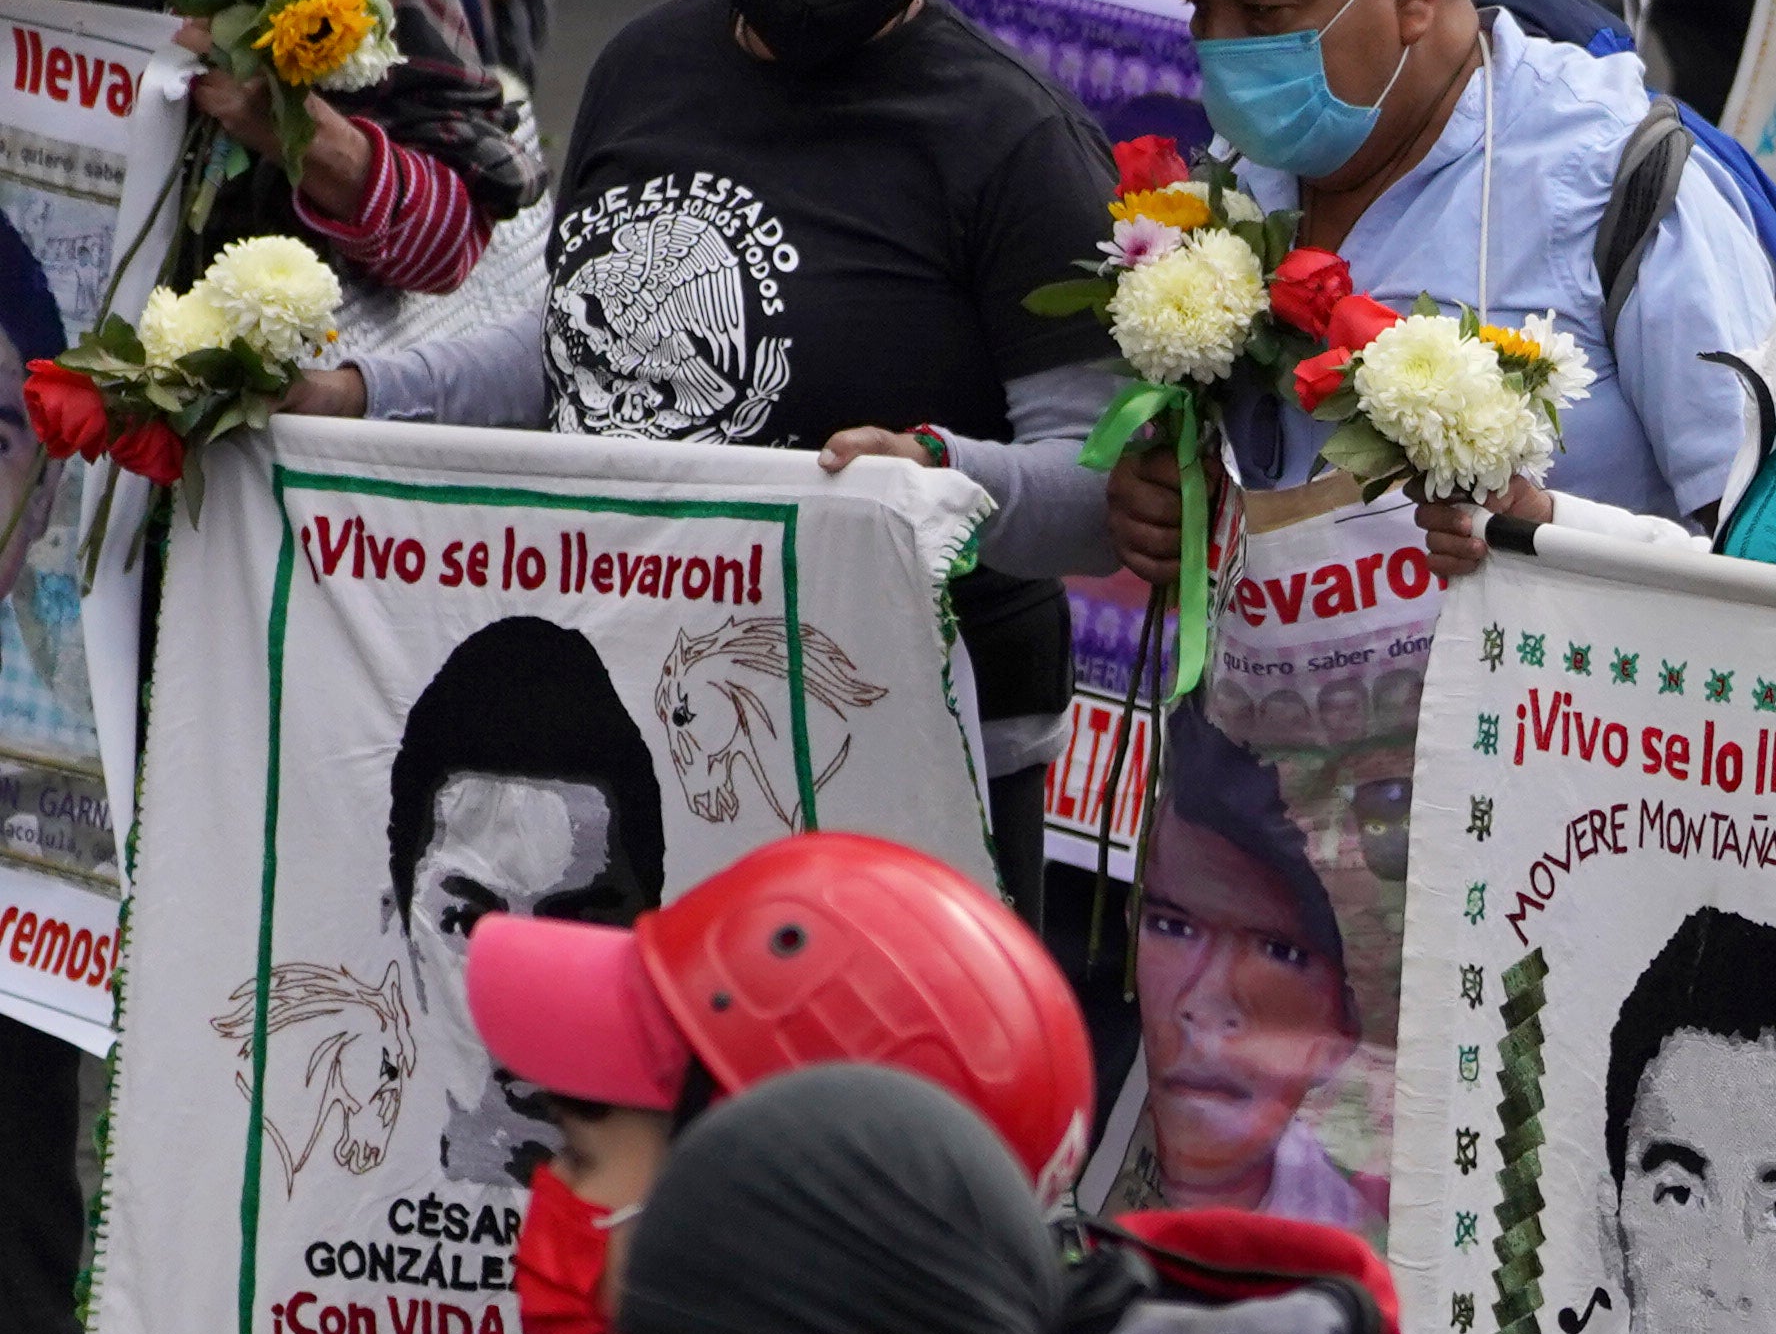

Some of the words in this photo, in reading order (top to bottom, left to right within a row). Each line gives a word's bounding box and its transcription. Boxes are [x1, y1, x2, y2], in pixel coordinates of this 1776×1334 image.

[12, 26, 144, 117] lleva
[83, 160, 126, 185] sabe
[558, 185, 631, 242] FUE
[640, 172, 681, 202] EL
[688, 170, 799, 273] ESTADO
[680, 198, 742, 238] SOMOS
[737, 232, 784, 317] TODOS
[300, 514, 426, 585] ¡Vivo
[438, 539, 491, 589] se
[501, 525, 547, 592] lo
[559, 530, 763, 606] llevaron!
[1228, 545, 1448, 628] evaro
[1223, 650, 1295, 678] quiero
[1306, 646, 1376, 674] saber
[1387, 632, 1435, 659] dón
[1513, 687, 1630, 768] ¡Vivo
[1641, 724, 1691, 782] se
[1700, 719, 1744, 793] lo
[1504, 802, 1629, 947] MOVERE
[0, 905, 121, 993] remos!
